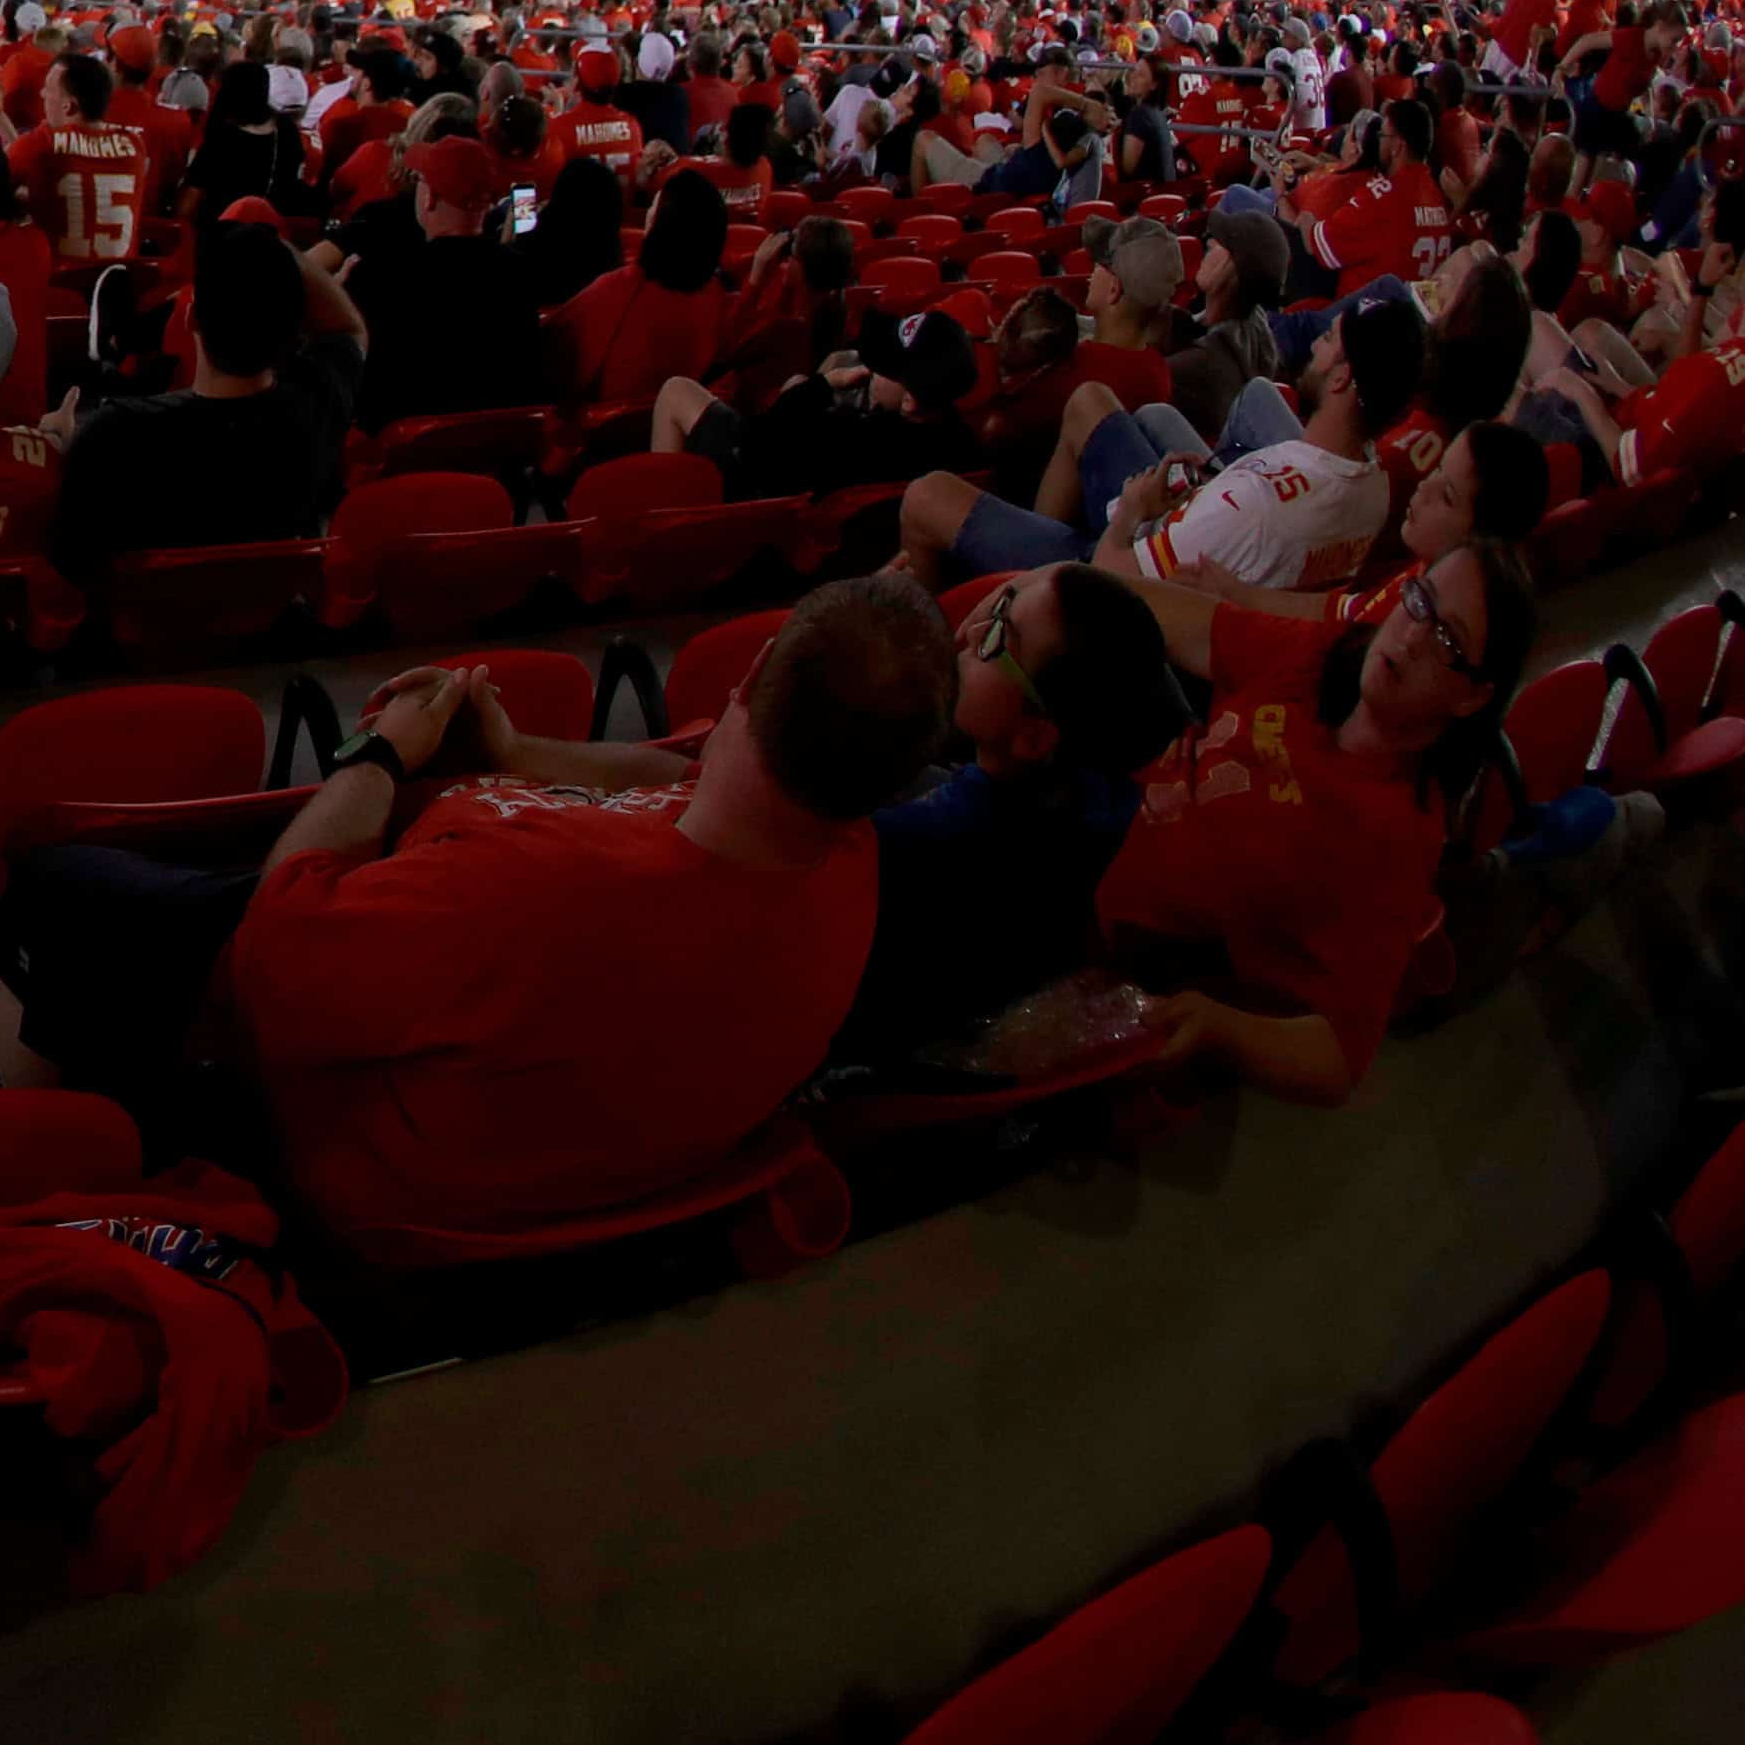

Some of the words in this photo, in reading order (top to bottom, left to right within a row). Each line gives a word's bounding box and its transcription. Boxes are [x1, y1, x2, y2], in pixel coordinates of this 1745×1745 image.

[53, 131, 137, 158] MAHOMES
[575, 121, 630, 145] MAHOMES
[56, 172, 136, 260] 15
